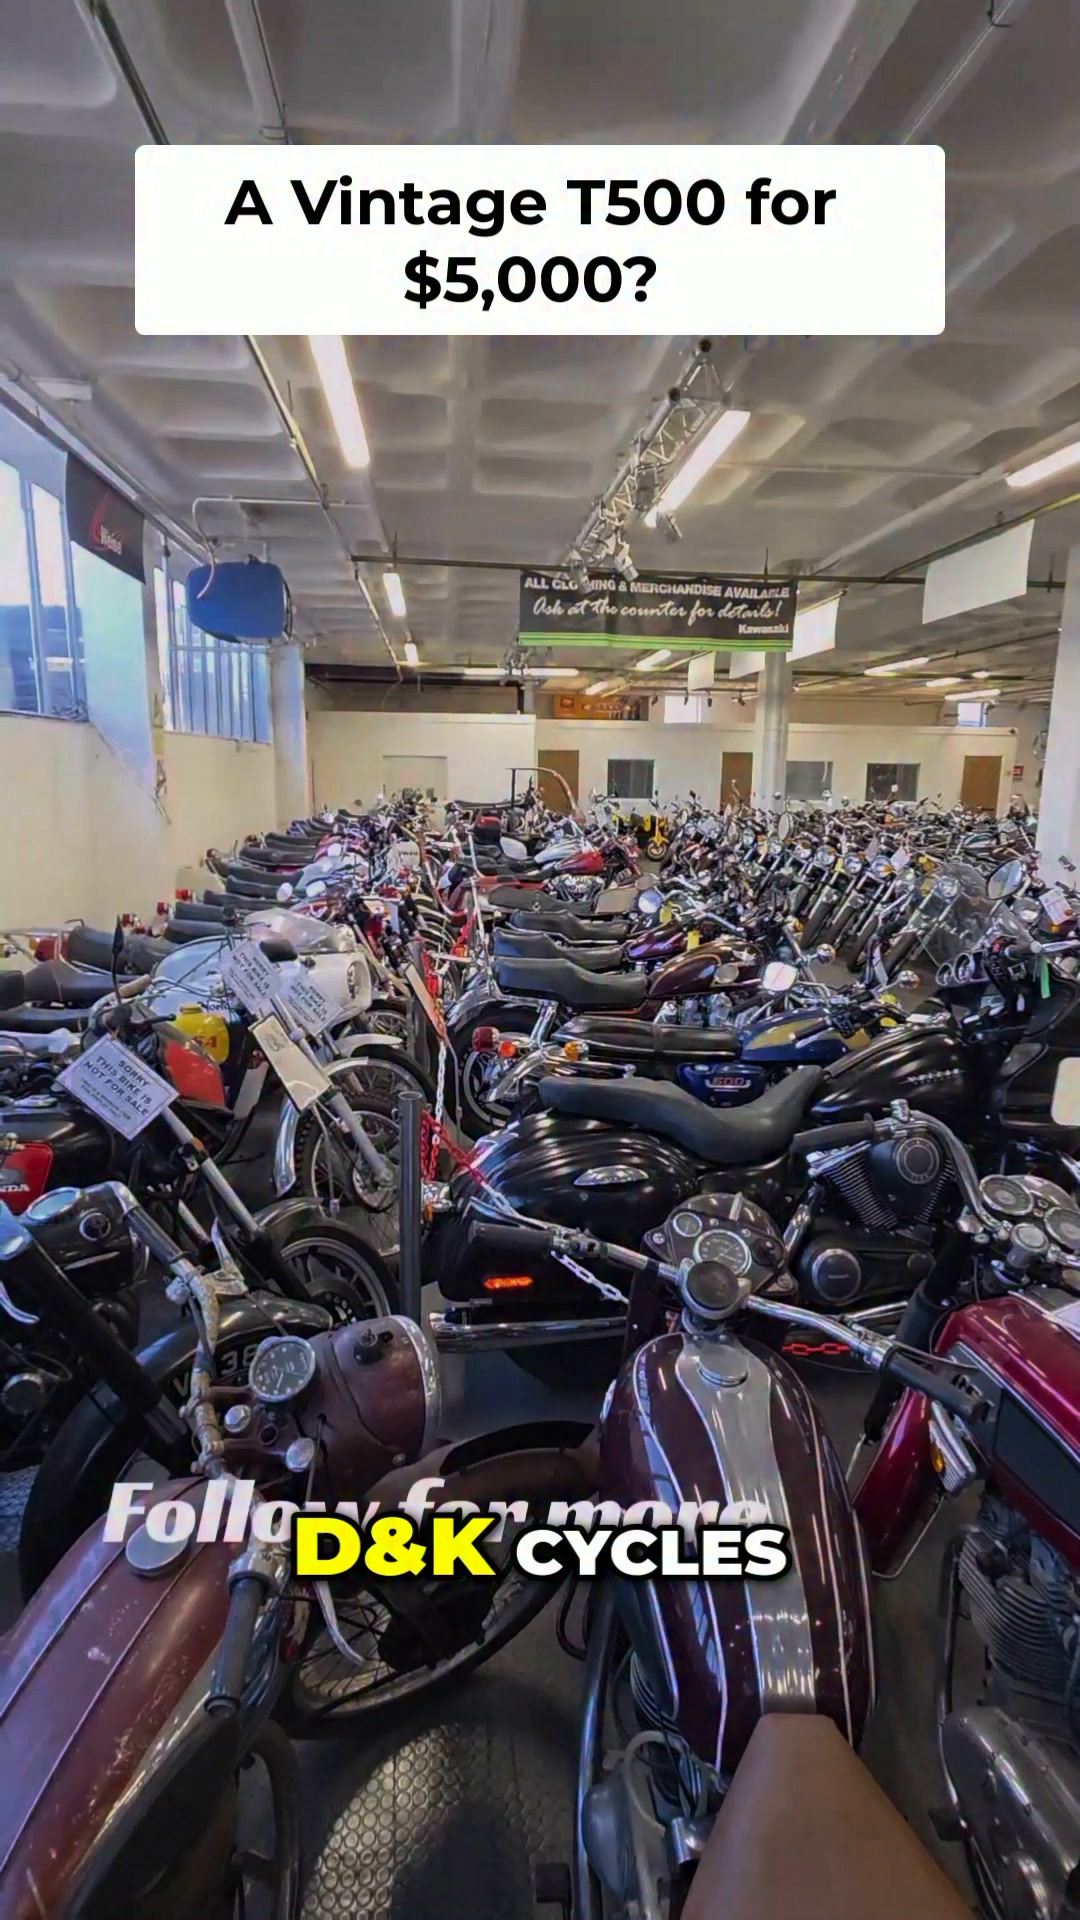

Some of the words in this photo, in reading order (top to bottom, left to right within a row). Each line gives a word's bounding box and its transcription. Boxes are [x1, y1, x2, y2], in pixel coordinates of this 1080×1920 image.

[524, 577, 549, 589] ALL
[618, 581, 627, 592] &
[630, 583, 721, 597] MERCHANDISE
[533, 596, 565, 615] Ask
[567, 599, 590, 615] at
[590, 596, 618, 615] the
[620, 600, 686, 617] counter
[687, 599, 715, 627] for
[717, 600, 783, 619] details!
[738, 623, 789, 635] Kawasaki
[96, 1056, 118, 1076] THIS
[119, 1075, 141, 1095] BIKE
[140, 1093, 152, 1104] IS
[119, 1060, 149, 1087] SORRY
[83, 1061, 105, 1079] NOT
[104, 1078, 125, 1096] FOR
[125, 1095, 149, 1116] SALE
